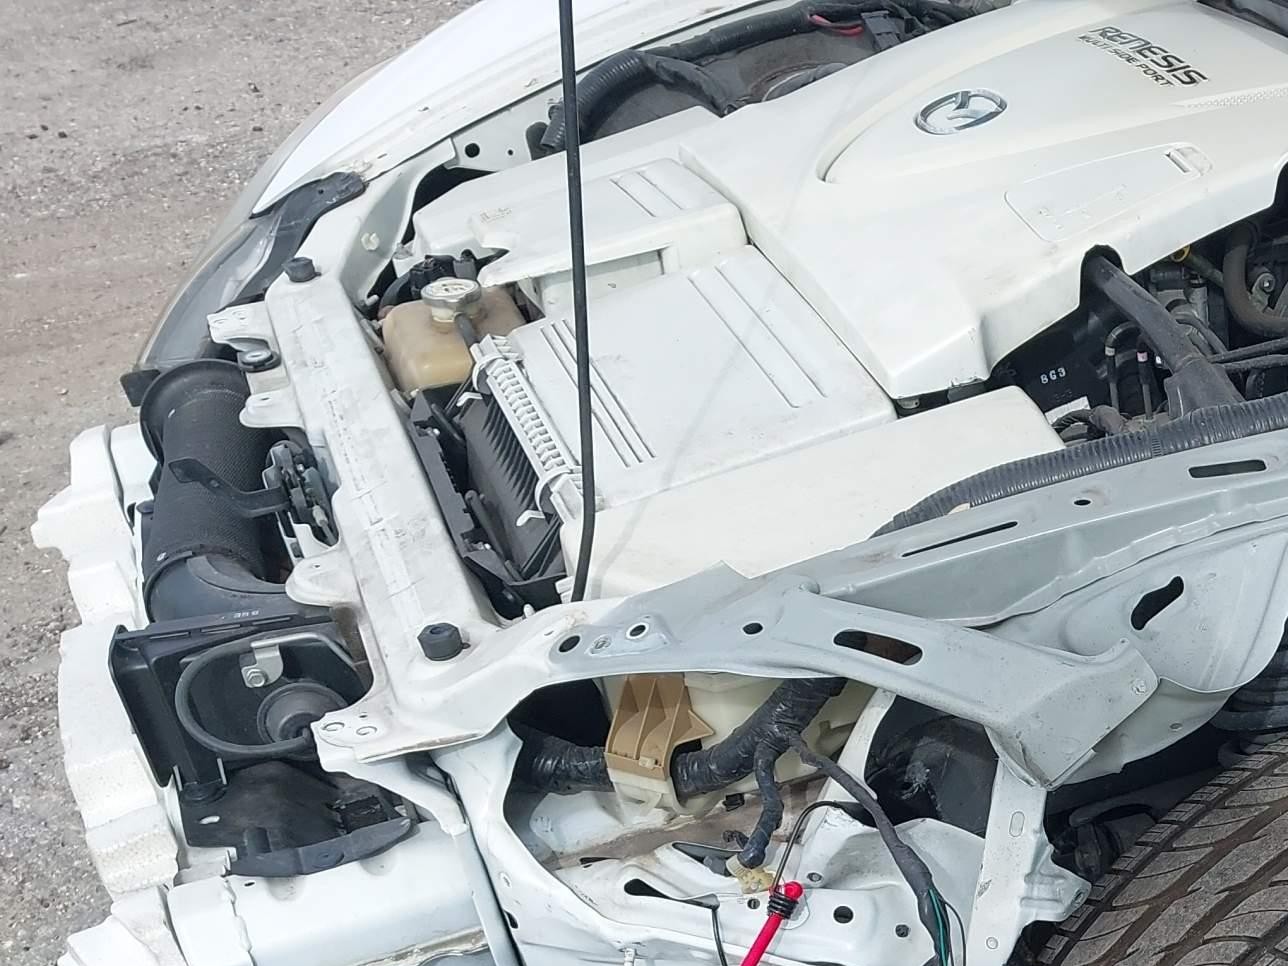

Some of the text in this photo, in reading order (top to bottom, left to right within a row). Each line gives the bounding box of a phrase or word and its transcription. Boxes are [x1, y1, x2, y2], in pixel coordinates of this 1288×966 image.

[1087, 26, 1208, 85] RENESIS
[1107, 47, 1137, 64] SIDE
[1135, 62, 1174, 88] PORT
